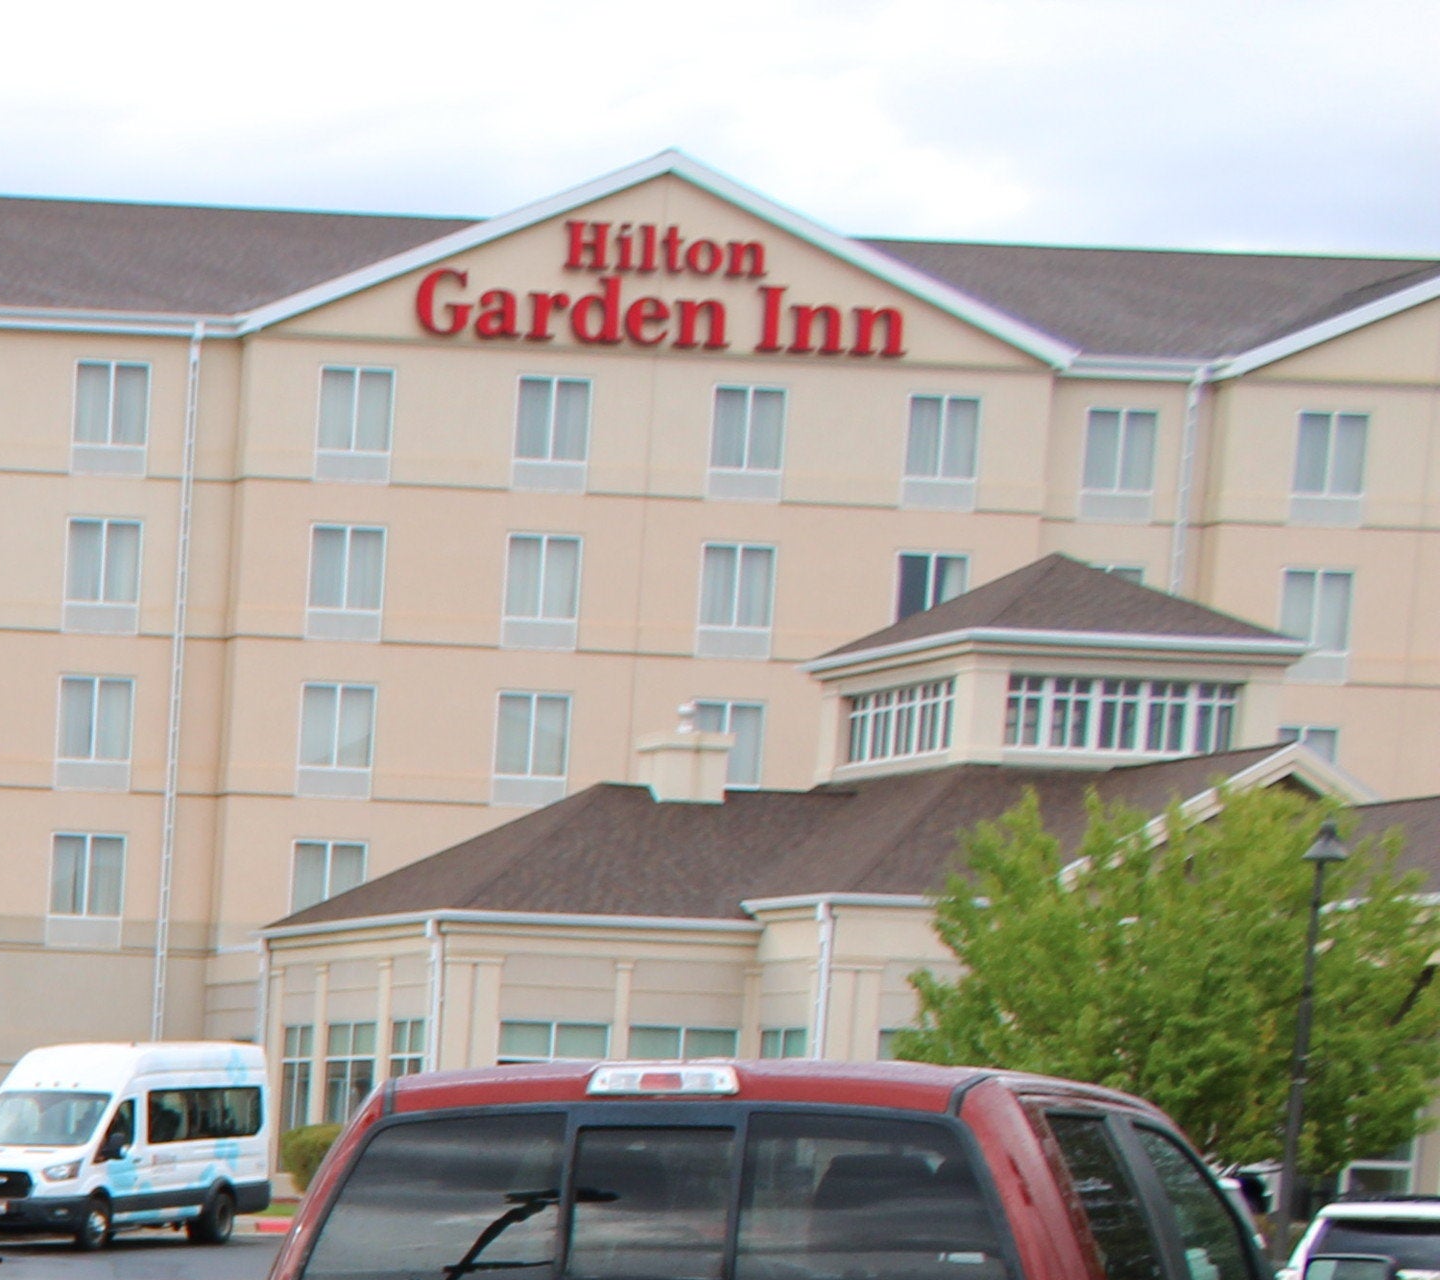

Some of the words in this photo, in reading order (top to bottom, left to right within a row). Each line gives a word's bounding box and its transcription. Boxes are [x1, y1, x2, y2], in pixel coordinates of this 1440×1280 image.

[564, 220, 766, 279] Hilton
[416, 267, 729, 350] Garden
[755, 285, 905, 357] Inn
